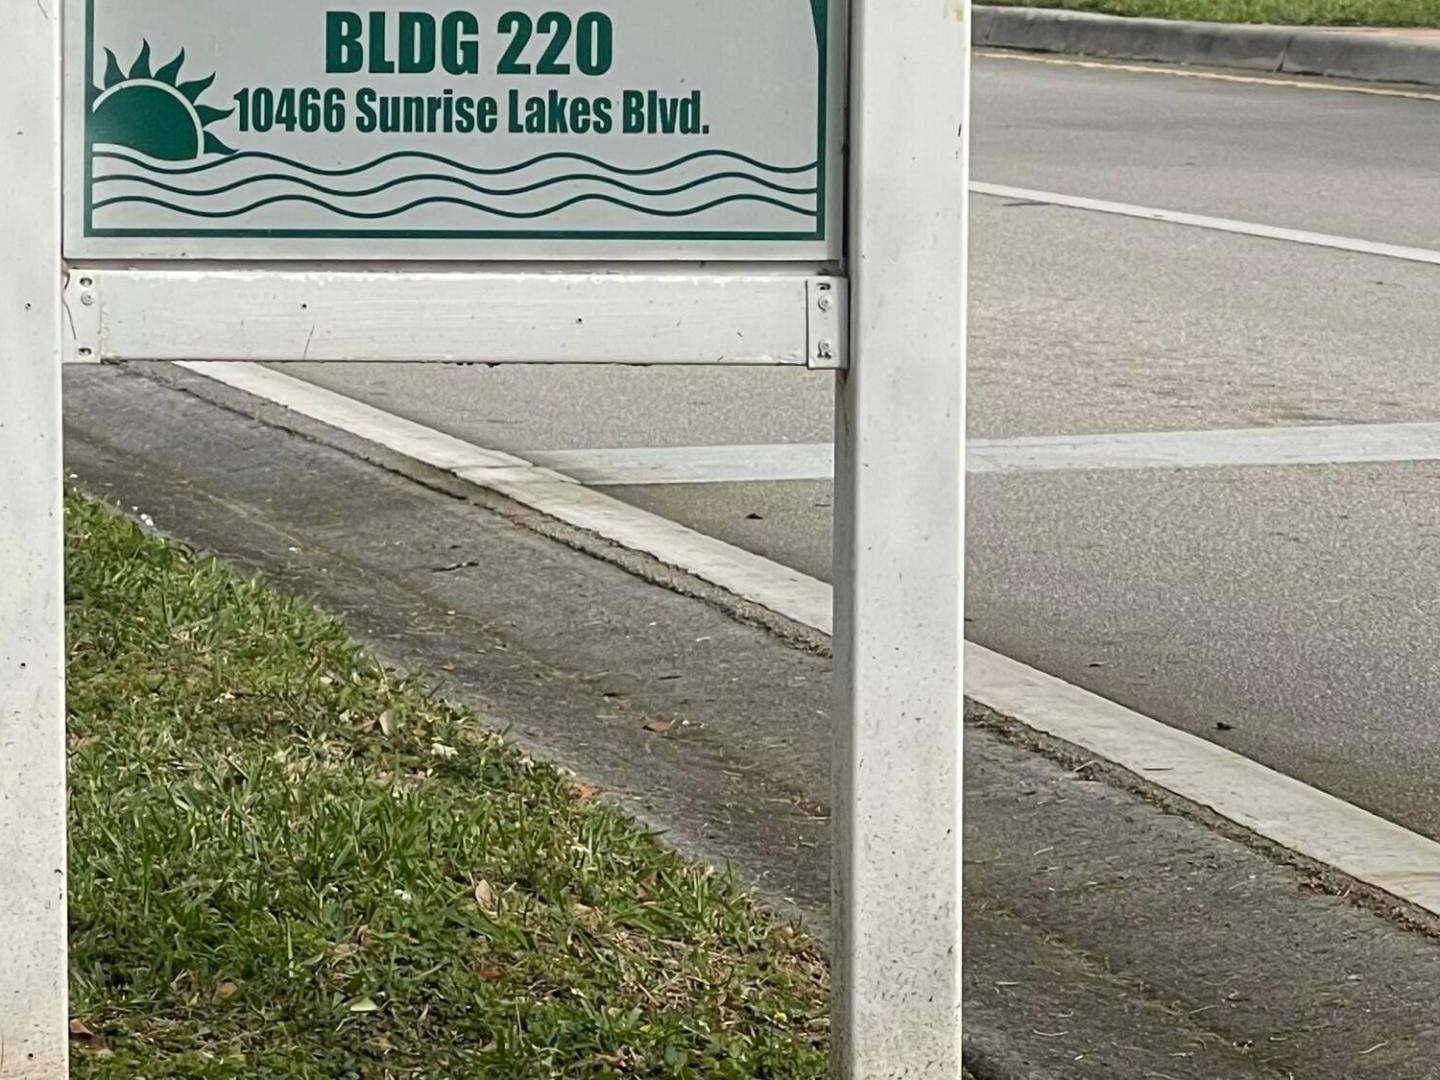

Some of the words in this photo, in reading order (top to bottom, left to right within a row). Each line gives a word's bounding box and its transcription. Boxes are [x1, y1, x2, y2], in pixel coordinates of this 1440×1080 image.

[325, 10, 479, 76] BLDG
[496, 10, 613, 76] 220
[233, 87, 346, 133] 10466
[355, 87, 498, 134] Sunrise
[508, 88, 613, 135] Lakes
[622, 89, 710, 135] Blvd.
